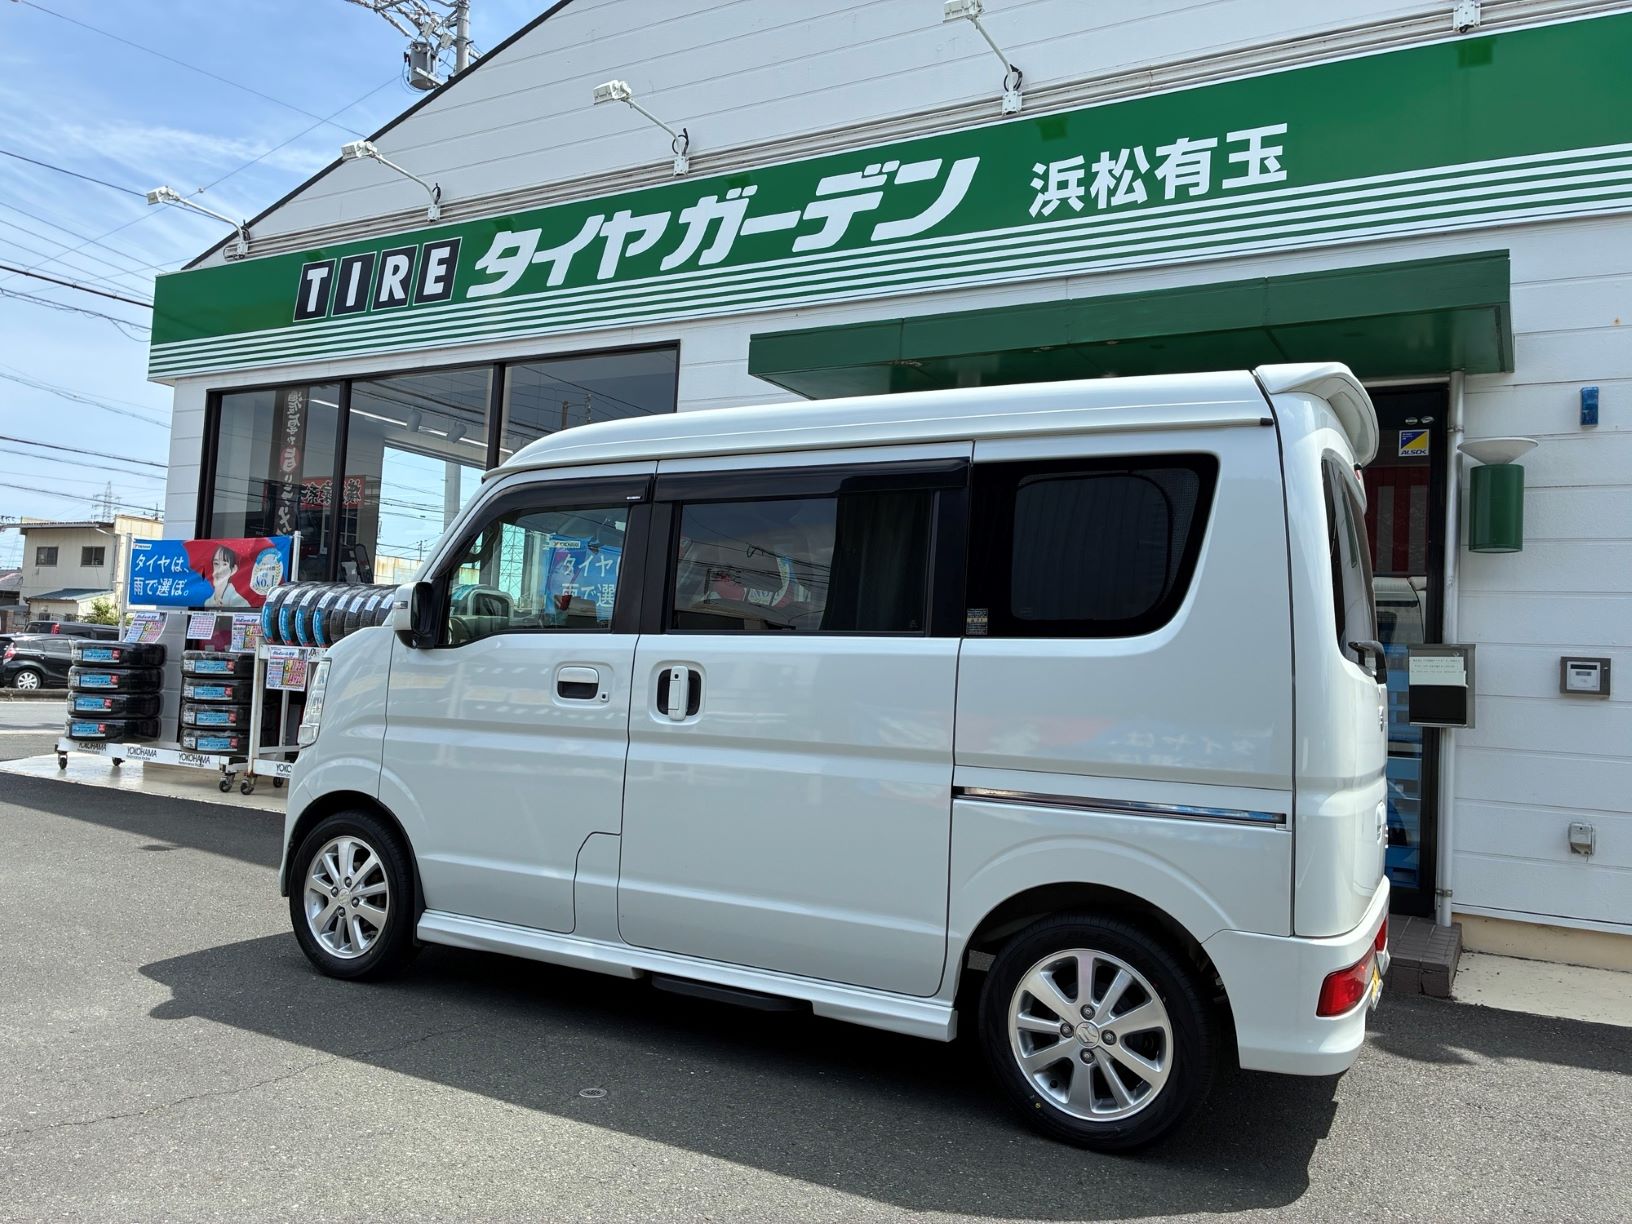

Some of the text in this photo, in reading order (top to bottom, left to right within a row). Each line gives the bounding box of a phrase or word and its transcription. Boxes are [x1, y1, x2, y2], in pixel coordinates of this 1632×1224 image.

[306, 123, 1287, 312] TIRE タイヤガーデン 浜松有玉
[134, 554, 189, 573] タイヤは、
[134, 577, 189, 596] 雨で選ぼ。
[128, 746, 157, 758] YOKOHAMA
[178, 753, 210, 764] YOKOHAMA
[276, 763, 293, 773] YOKO
